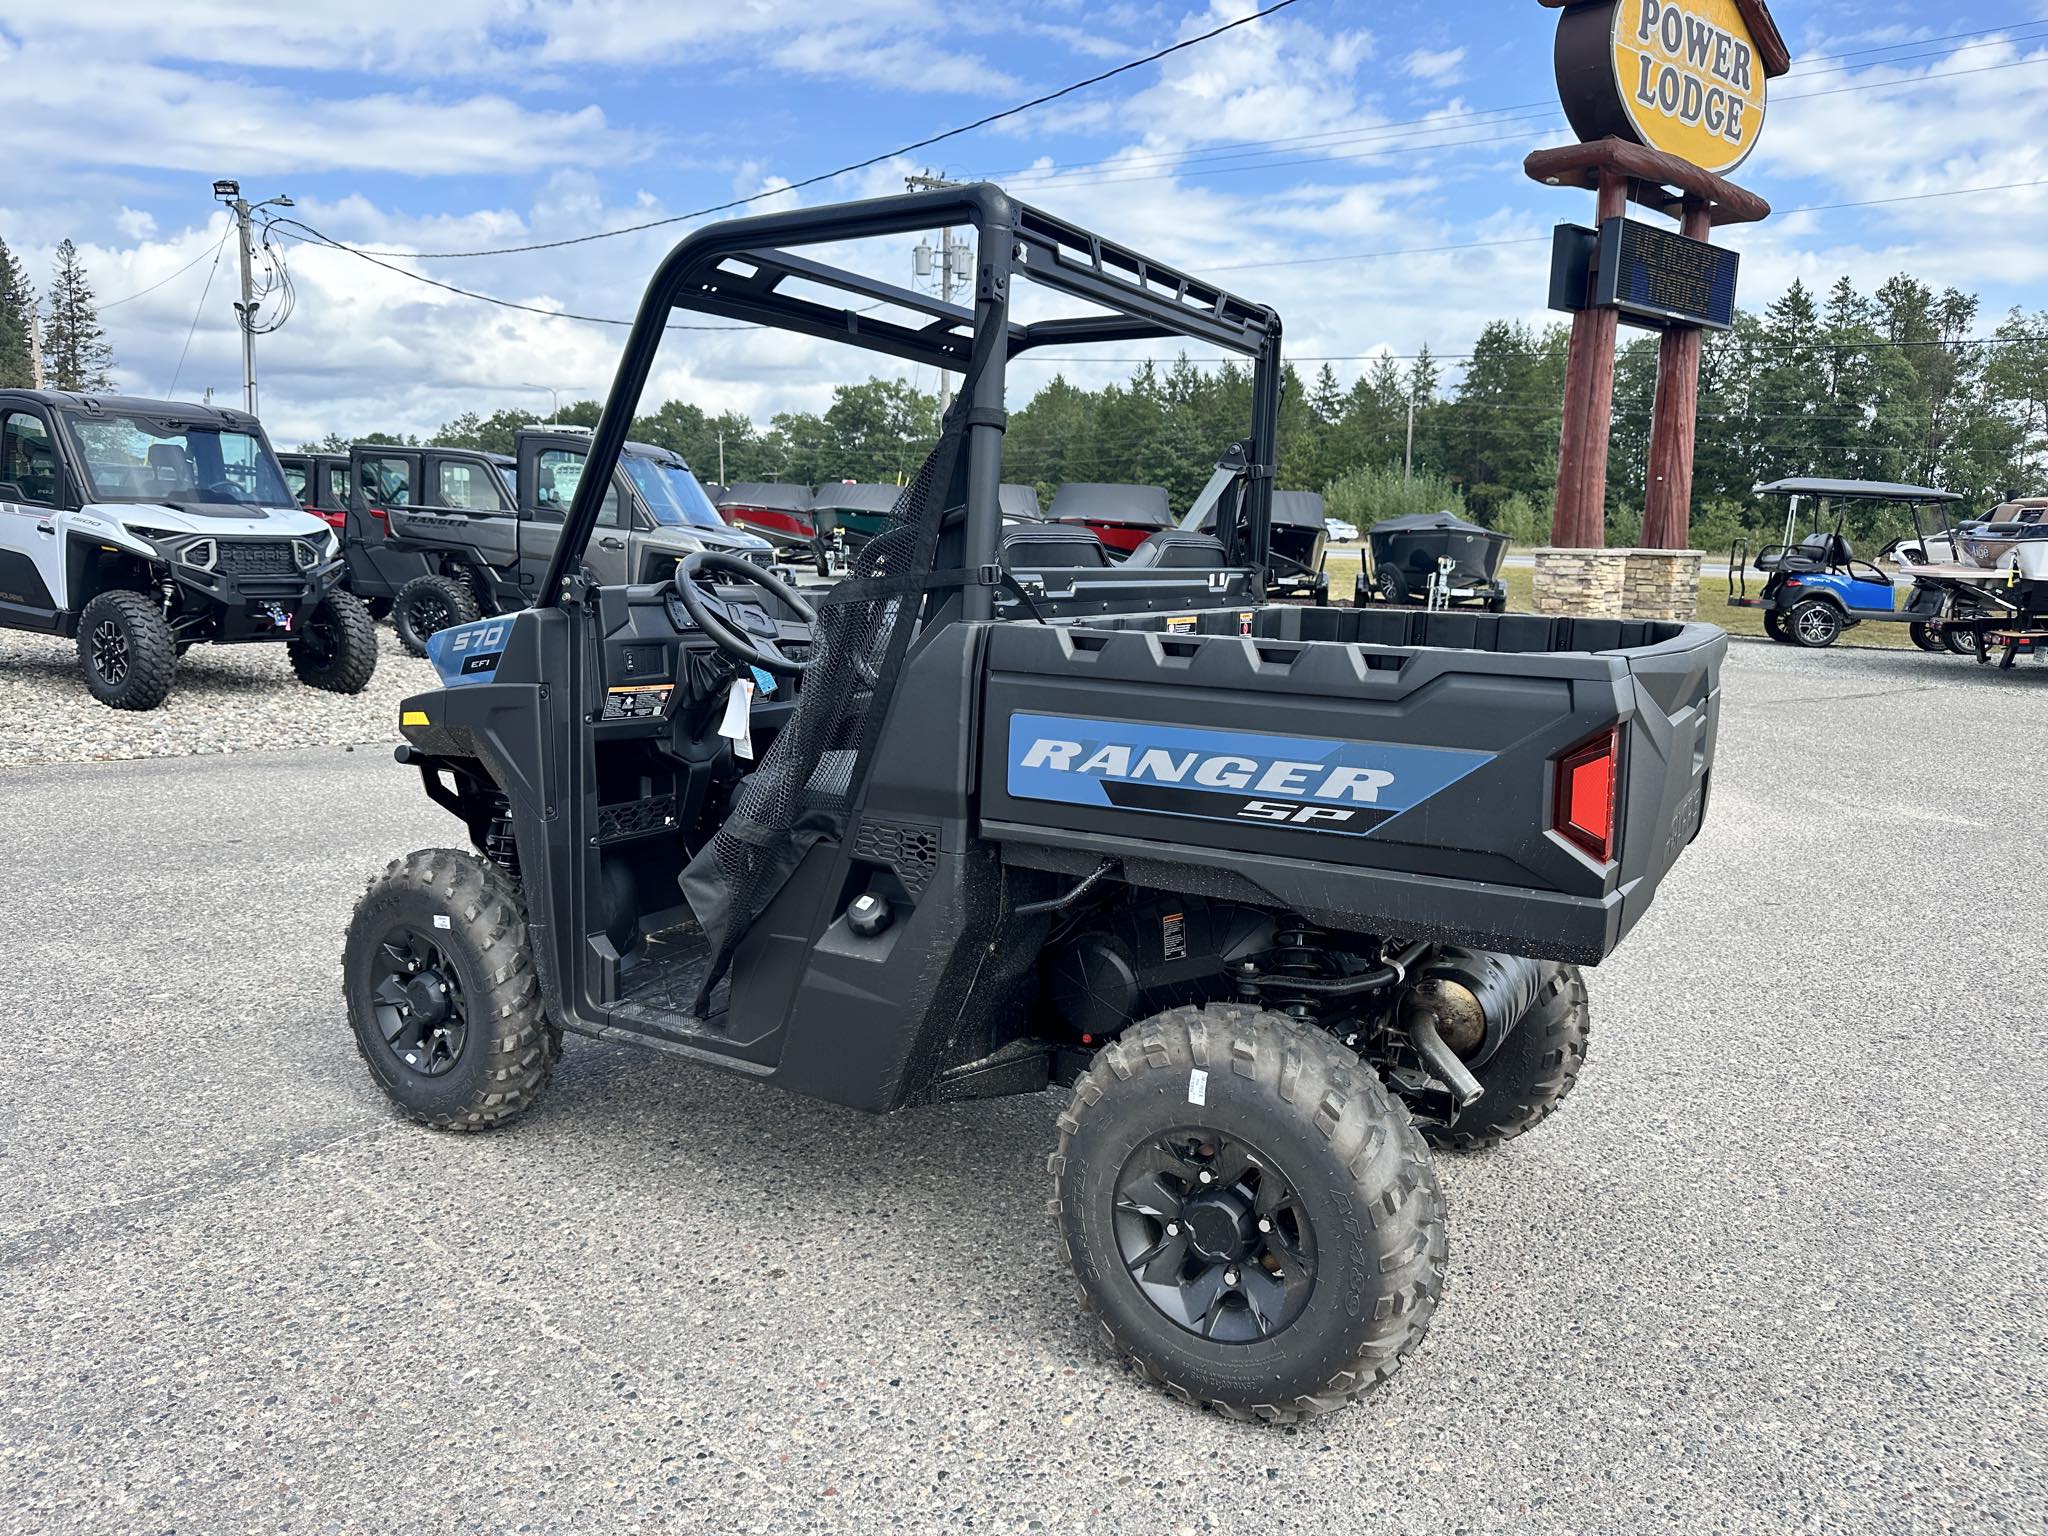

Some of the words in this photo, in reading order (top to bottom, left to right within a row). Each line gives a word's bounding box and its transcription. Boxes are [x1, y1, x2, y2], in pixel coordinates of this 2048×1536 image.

[1638, 0, 1751, 91] POWER
[1637, 55, 1744, 142] LODGE
[406, 515, 469, 528] RANGER
[220, 550, 290, 561] POLARIS
[452, 626, 504, 651] 570
[471, 659, 490, 668] EFI
[1020, 738, 1395, 802] RANGER
[1236, 801, 1356, 823] SP
